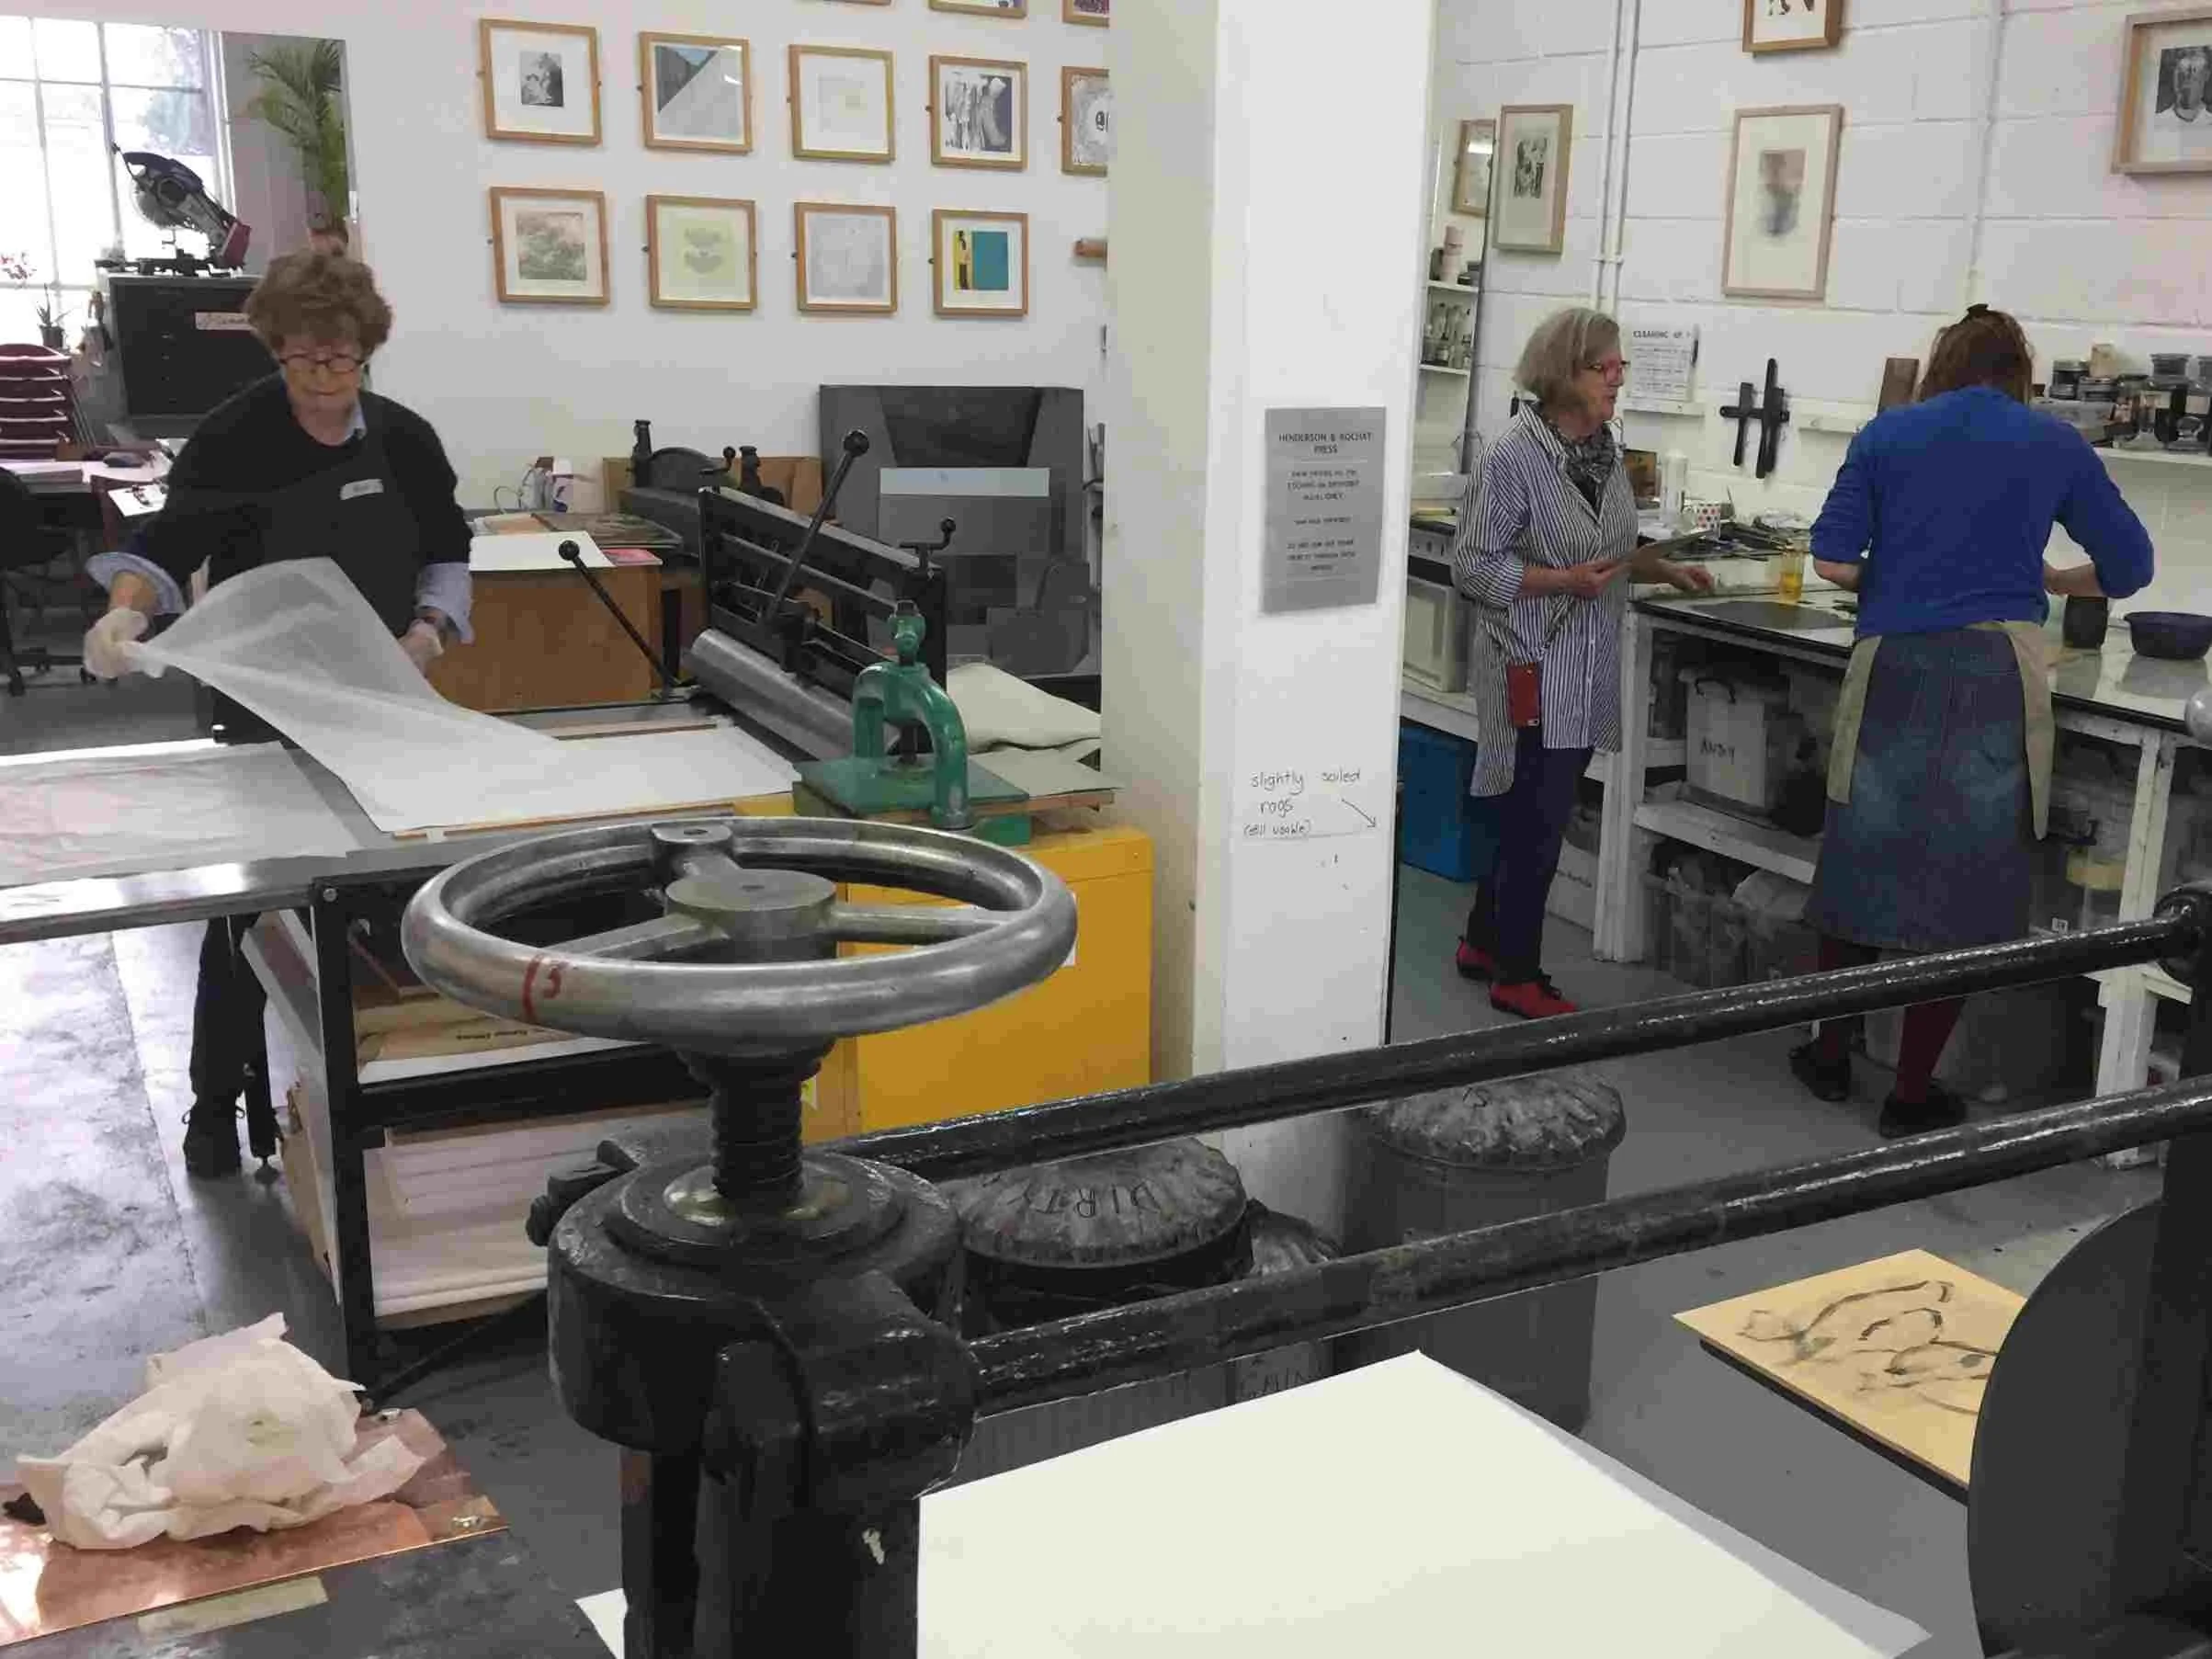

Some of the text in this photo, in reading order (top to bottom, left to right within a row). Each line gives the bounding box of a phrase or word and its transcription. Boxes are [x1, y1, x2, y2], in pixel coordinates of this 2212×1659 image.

[1278, 433, 1327, 442] HENDERSON
[1313, 444, 1339, 454] PRESS
[1251, 766, 1361, 796] slightly soiled
[1260, 797, 1294, 818] rags
